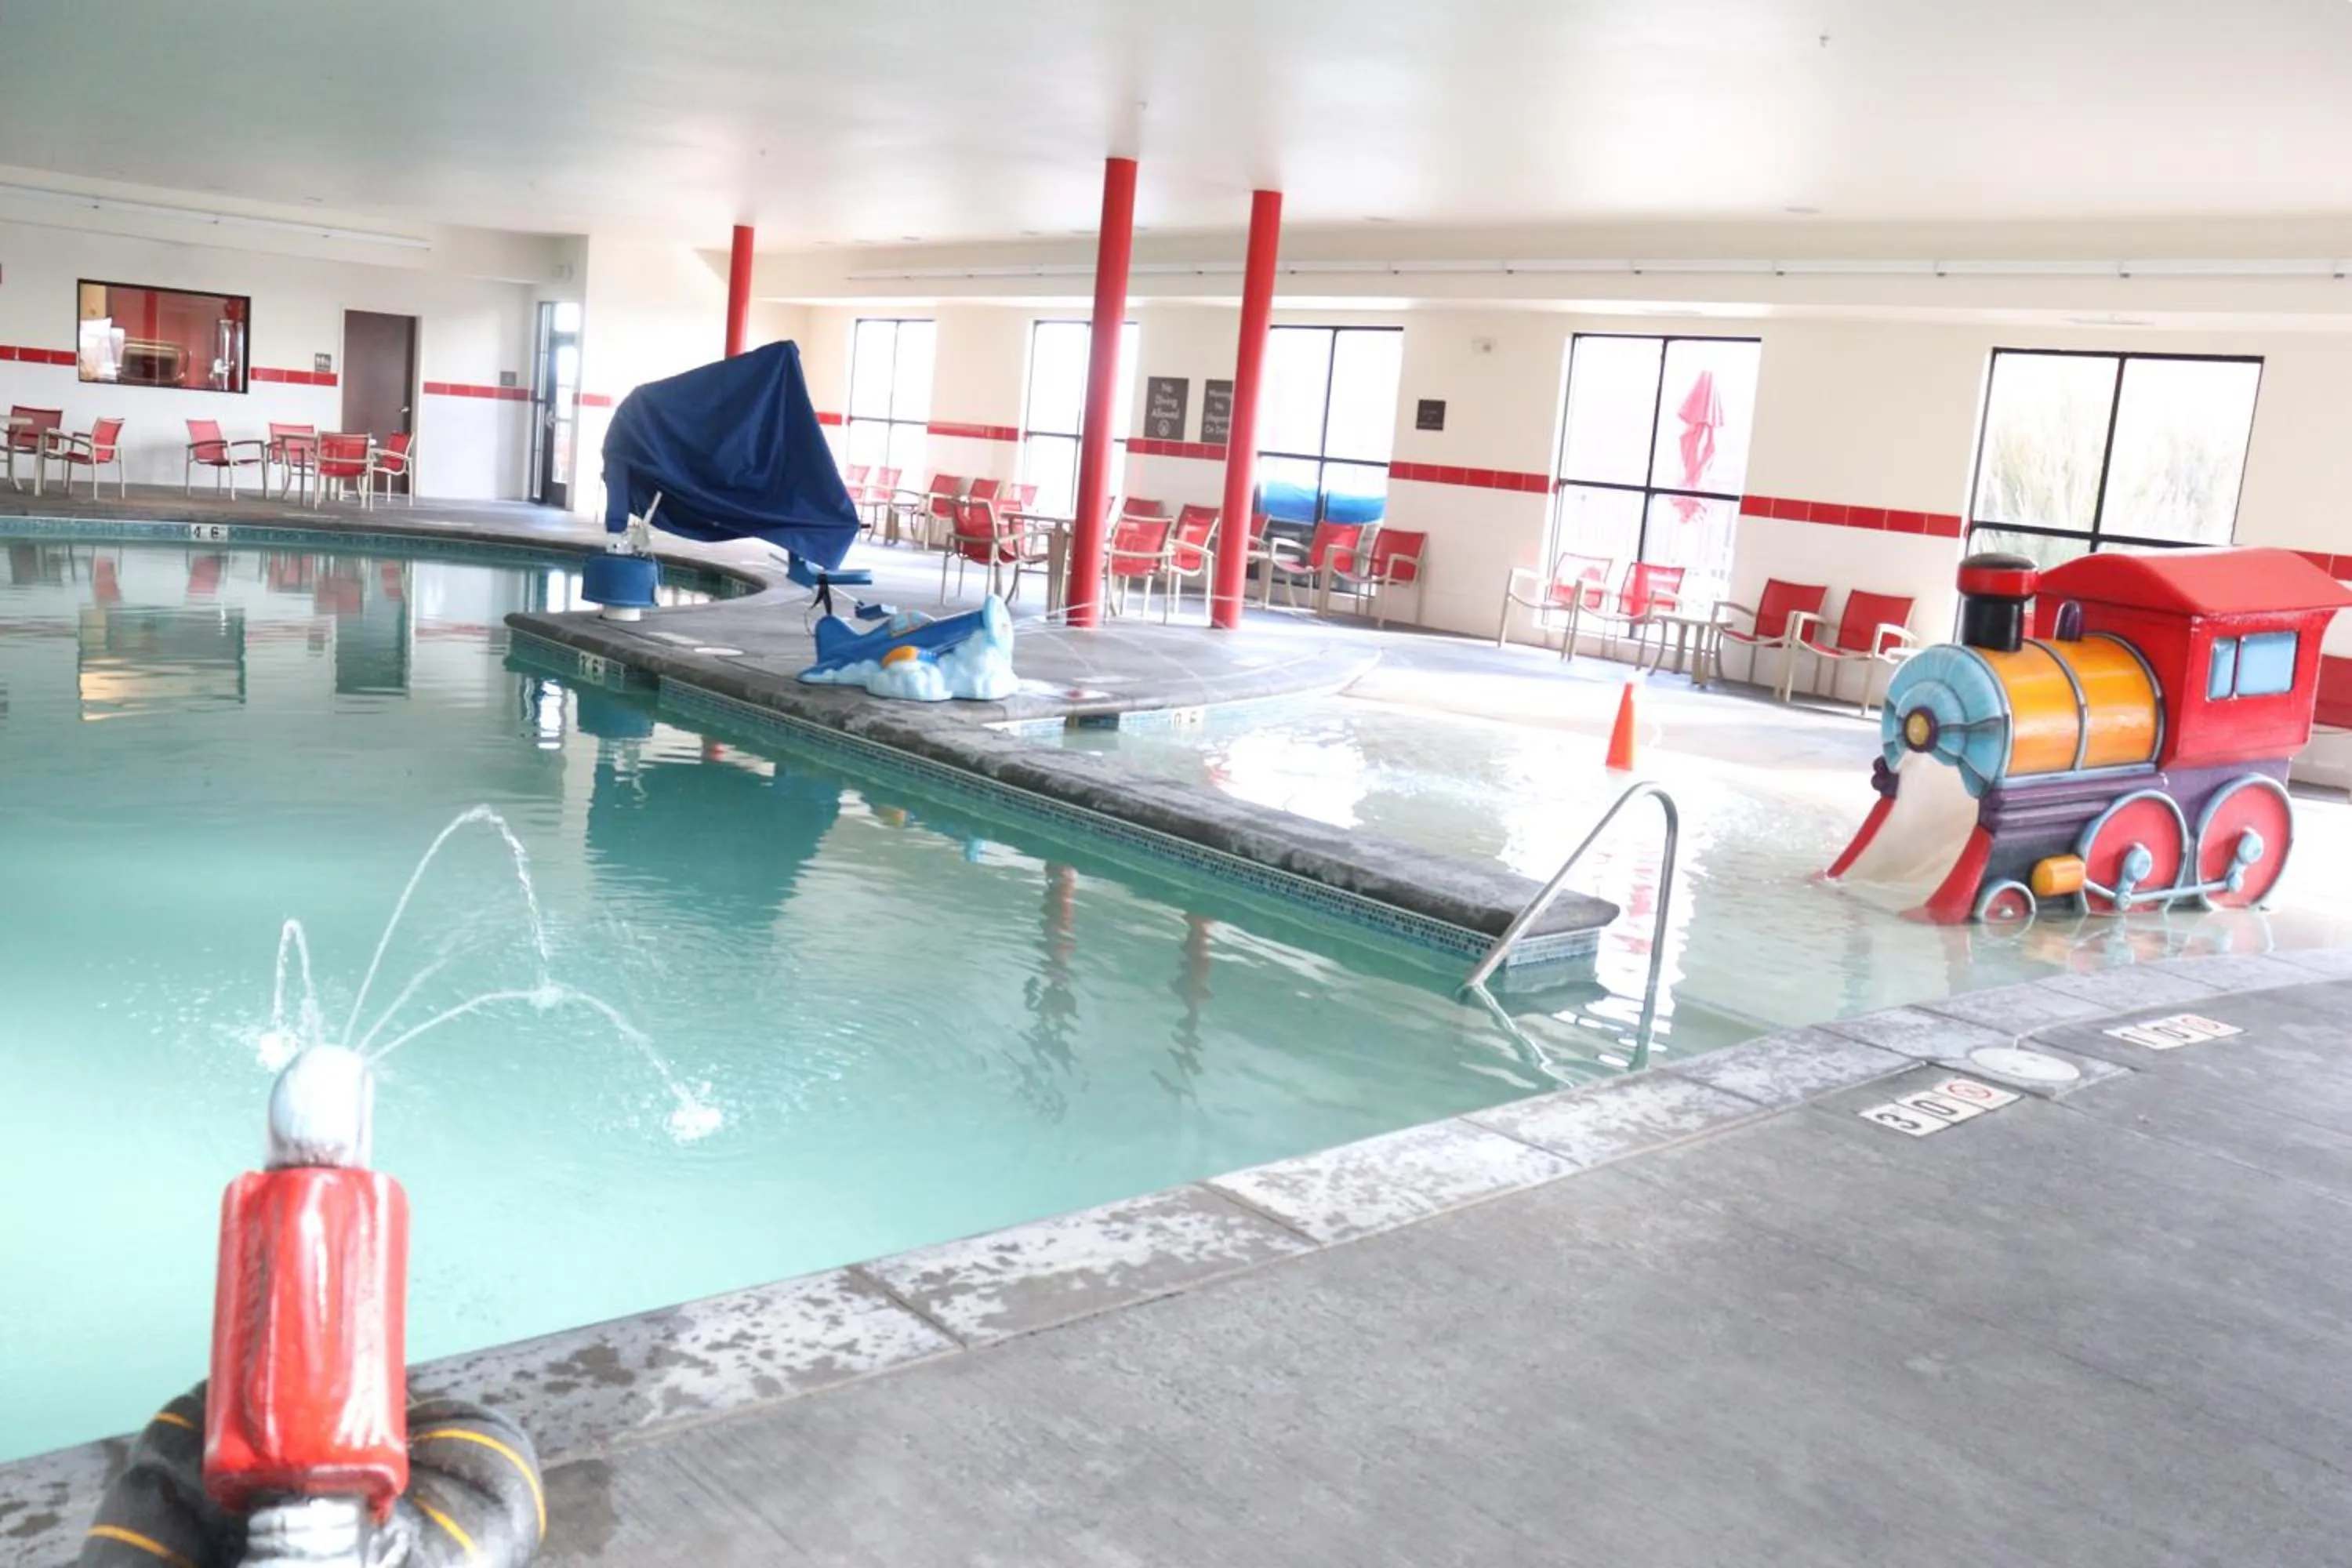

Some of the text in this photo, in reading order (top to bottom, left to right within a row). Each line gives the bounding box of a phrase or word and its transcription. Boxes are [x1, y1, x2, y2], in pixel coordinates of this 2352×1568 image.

[1161, 383, 1174, 394] No
[1155, 394, 1178, 408] Diving
[1151, 407, 1180, 420] Allowed
